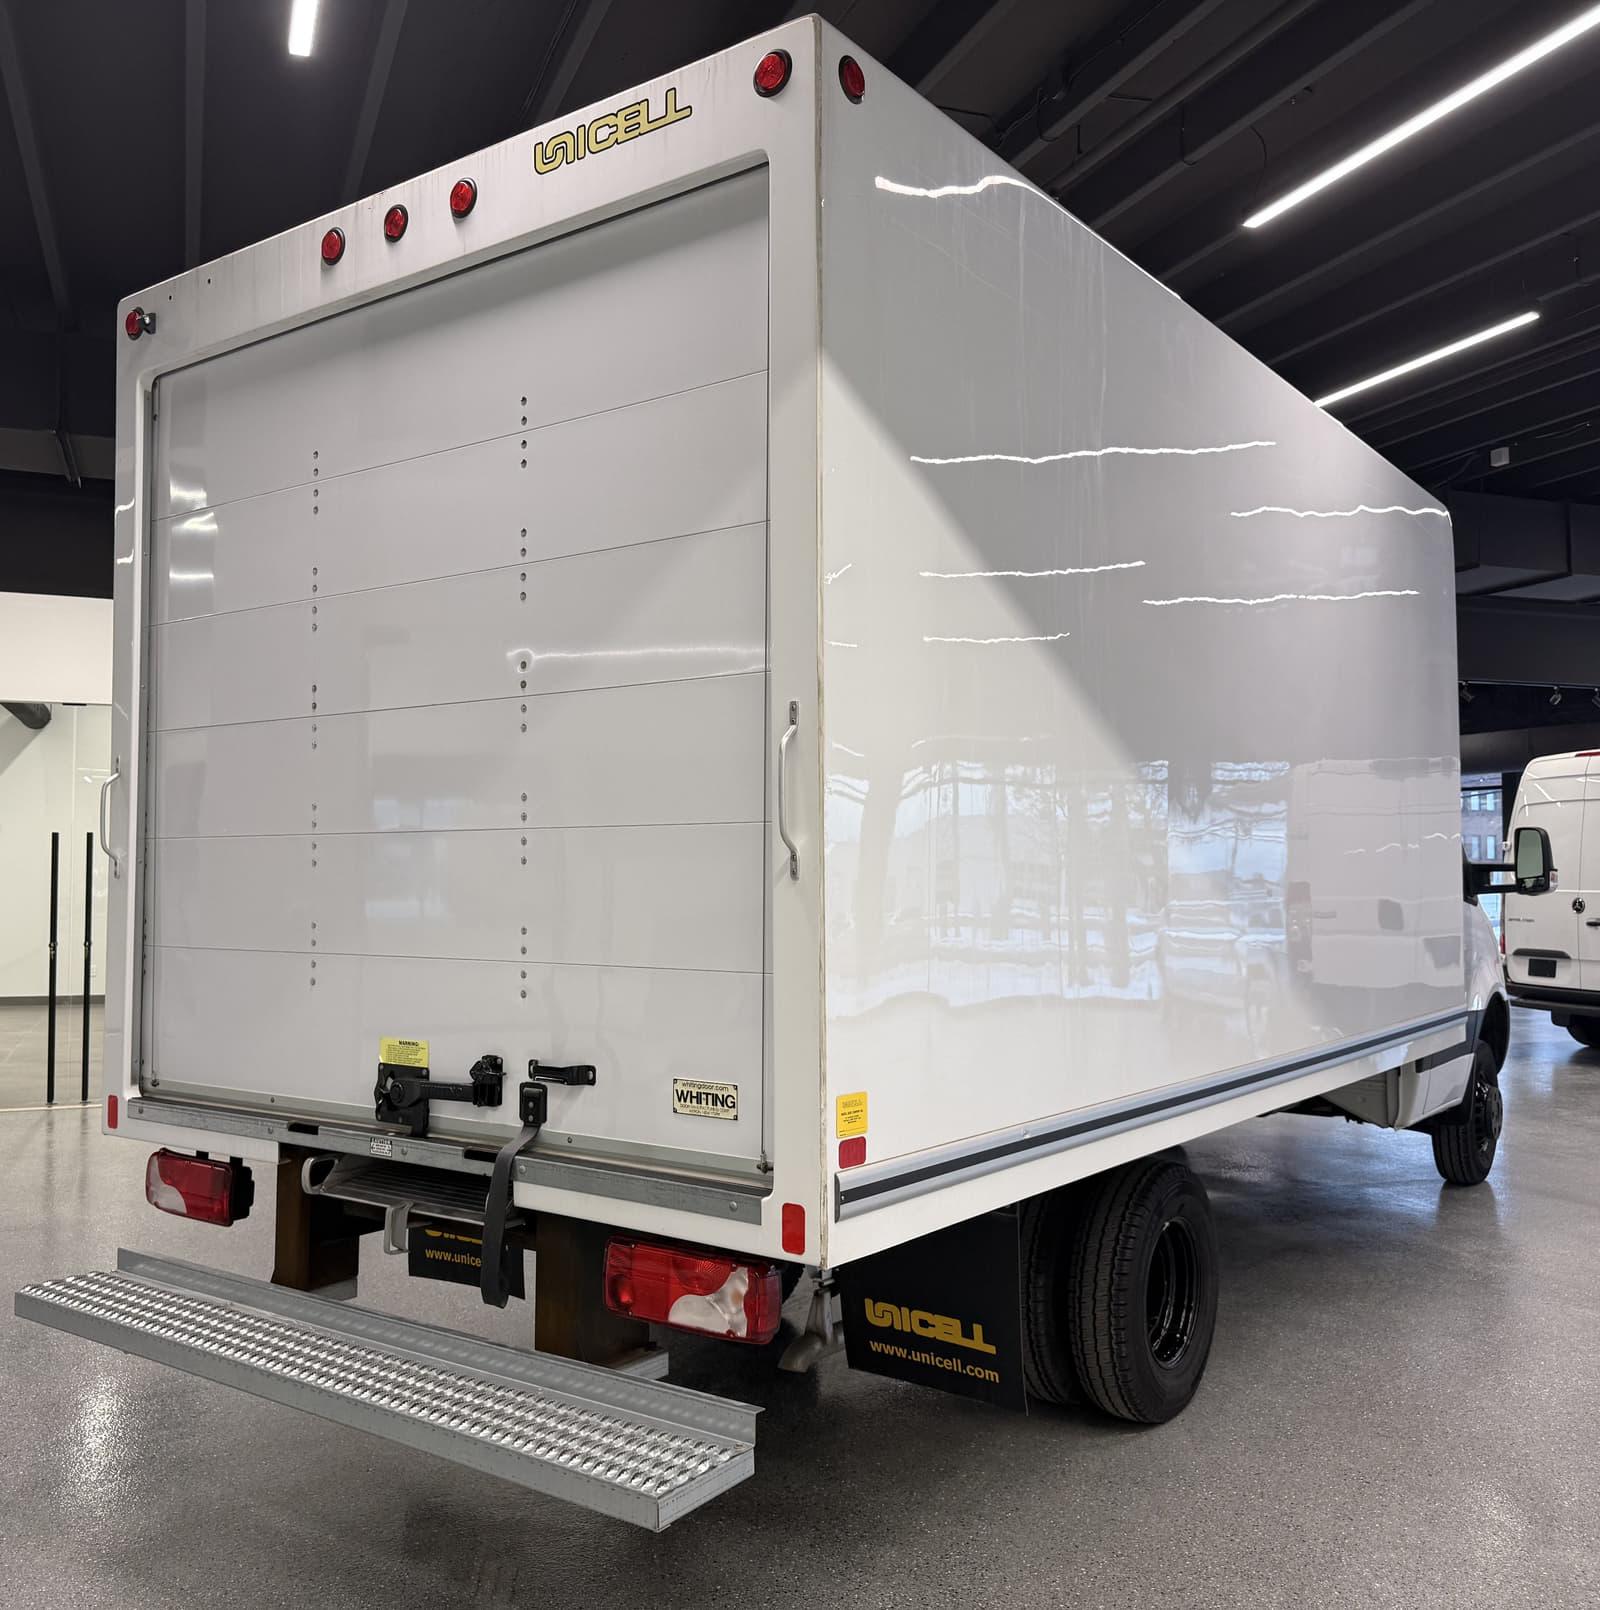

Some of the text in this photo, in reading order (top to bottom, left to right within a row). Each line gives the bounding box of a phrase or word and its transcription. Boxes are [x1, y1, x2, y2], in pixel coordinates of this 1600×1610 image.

[534, 87, 692, 175] UNICELL
[675, 1089, 736, 1109] WHITING
[682, 1082, 729, 1092] whitingdoor.com
[425, 1247, 482, 1267] www.unice
[864, 1298, 997, 1355] UNICELL
[869, 1340, 1000, 1384] www.unicell.com
